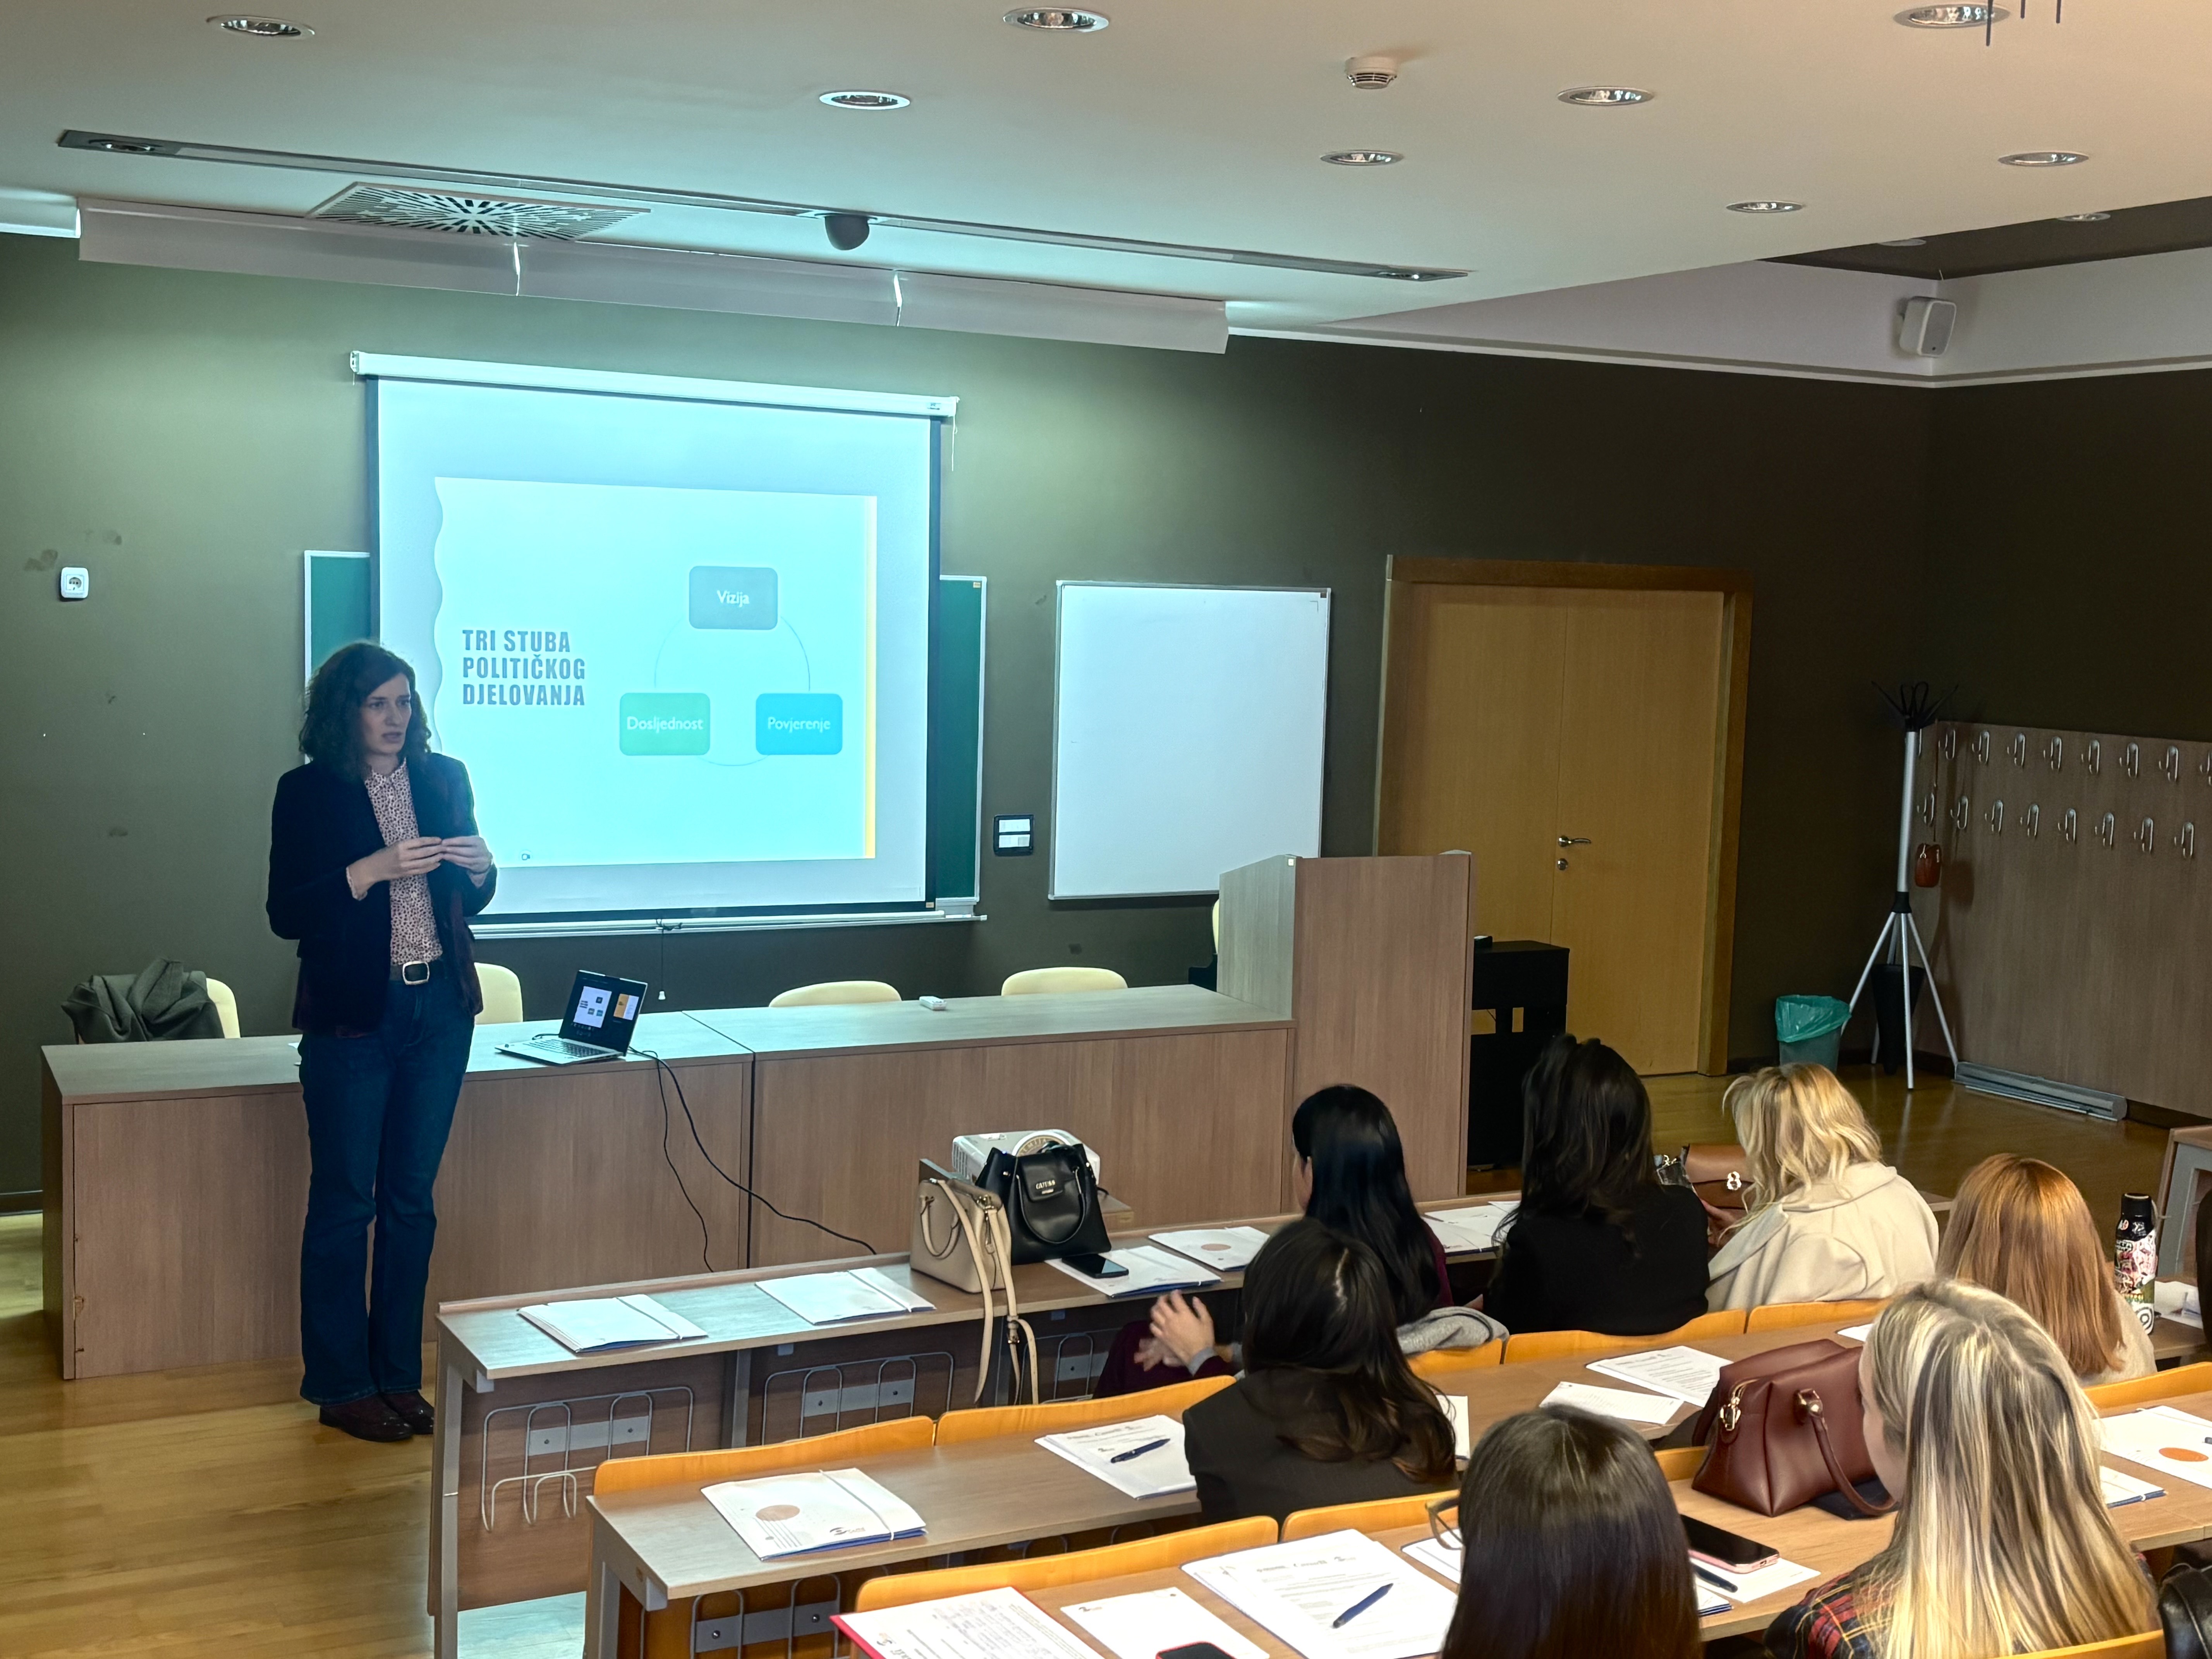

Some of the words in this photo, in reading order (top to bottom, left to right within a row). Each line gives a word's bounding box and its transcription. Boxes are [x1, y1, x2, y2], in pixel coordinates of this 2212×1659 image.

[717, 590, 750, 607] Vizija
[462, 630, 496, 651] TRI
[504, 630, 570, 652] STUBA
[463, 654, 585, 679] POLITIČKOG
[463, 684, 585, 706] DJELOVANJA
[627, 716, 704, 733] Dosljednost
[768, 717, 831, 733] Povjerenje
